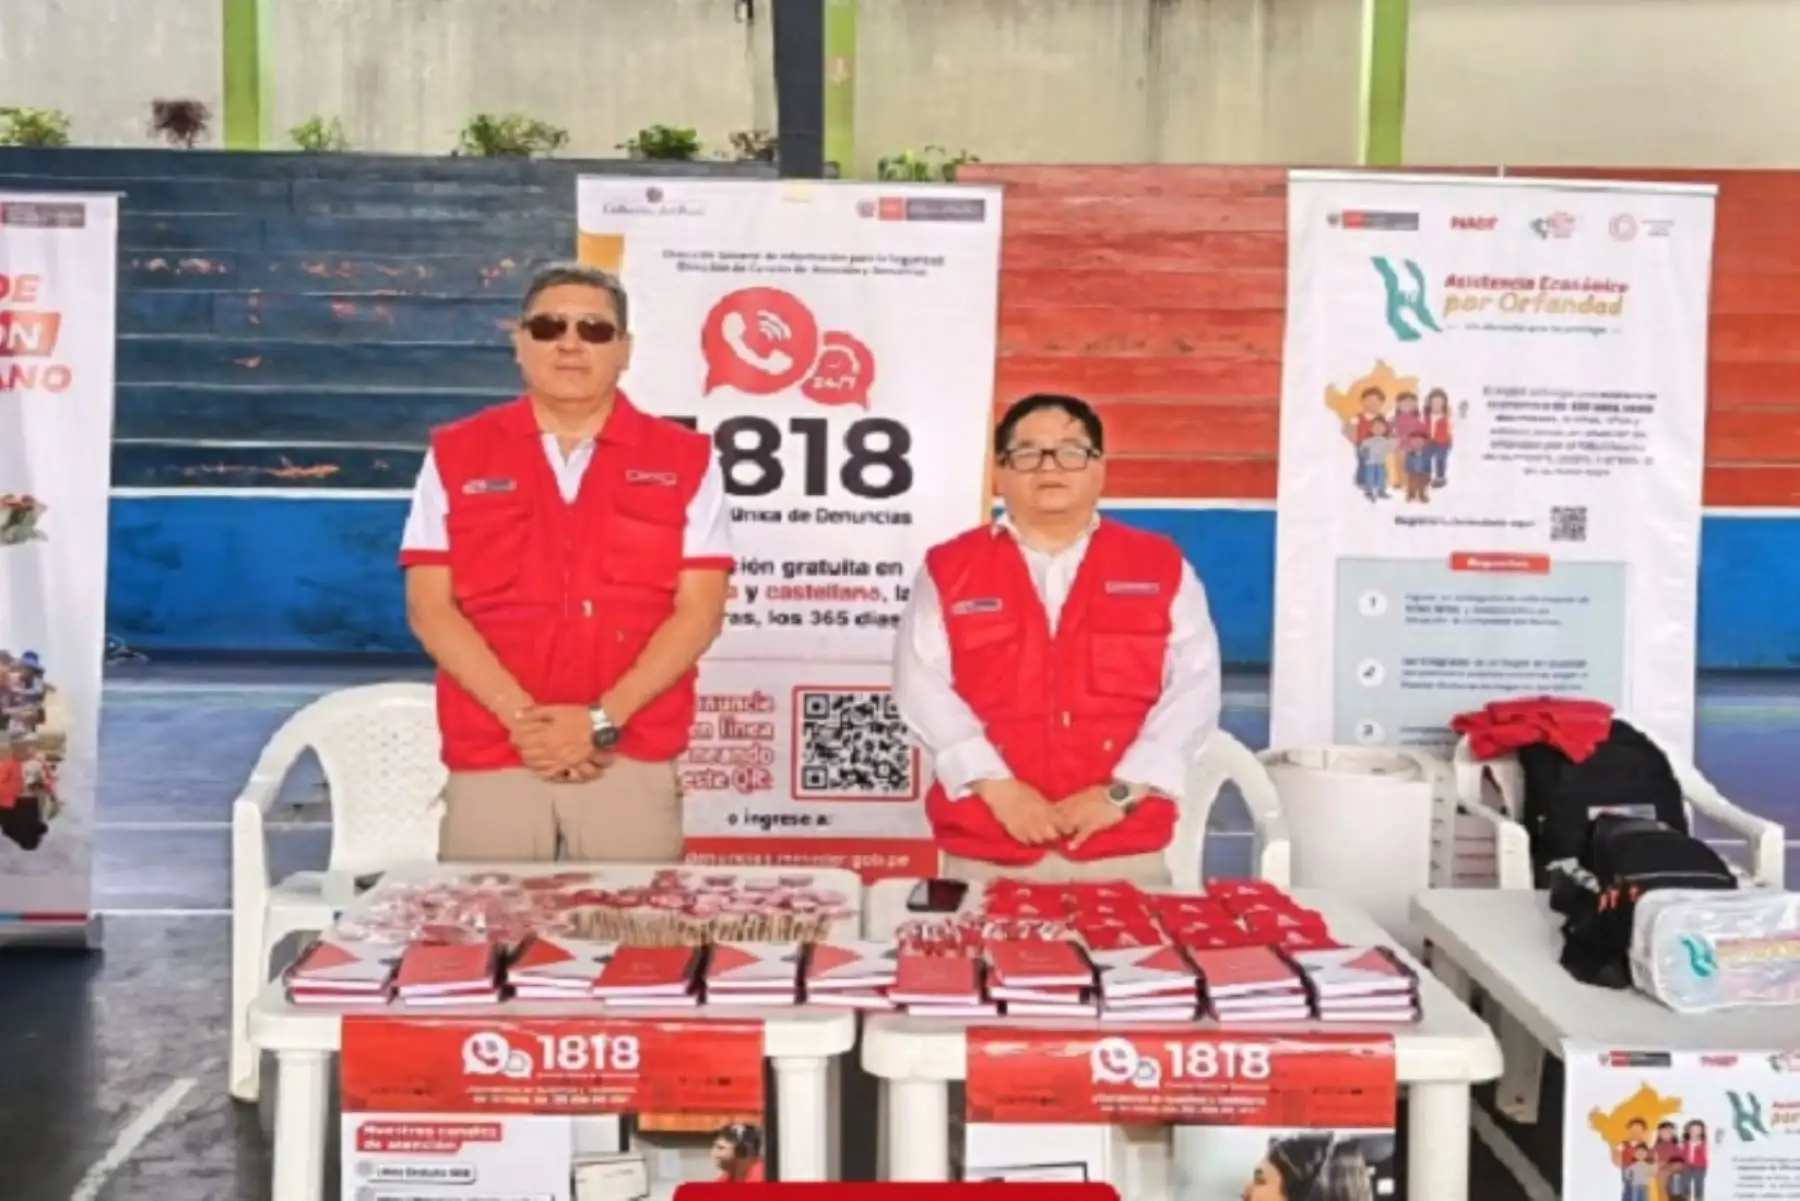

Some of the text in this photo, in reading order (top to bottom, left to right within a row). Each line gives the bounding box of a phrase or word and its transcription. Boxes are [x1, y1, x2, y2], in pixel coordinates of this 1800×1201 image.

[1444, 291, 1623, 318] por Orfandad
[0, 322, 42, 350] N
[813, 376, 857, 392] 24/7
[662, 415, 913, 499] 818
[788, 507, 811, 524] de
[815, 507, 913, 525] Denuncias
[736, 557, 904, 578] ión gratuita en
[744, 585, 758, 602] y
[767, 610, 803, 625] los
[809, 609, 849, 627] 365
[697, 689, 776, 714] nuncia
[727, 814, 738, 825] o
[744, 808, 812, 830] ingrese
[538, 1034, 640, 1071] 1818
[1164, 1042, 1271, 1079] 1818
